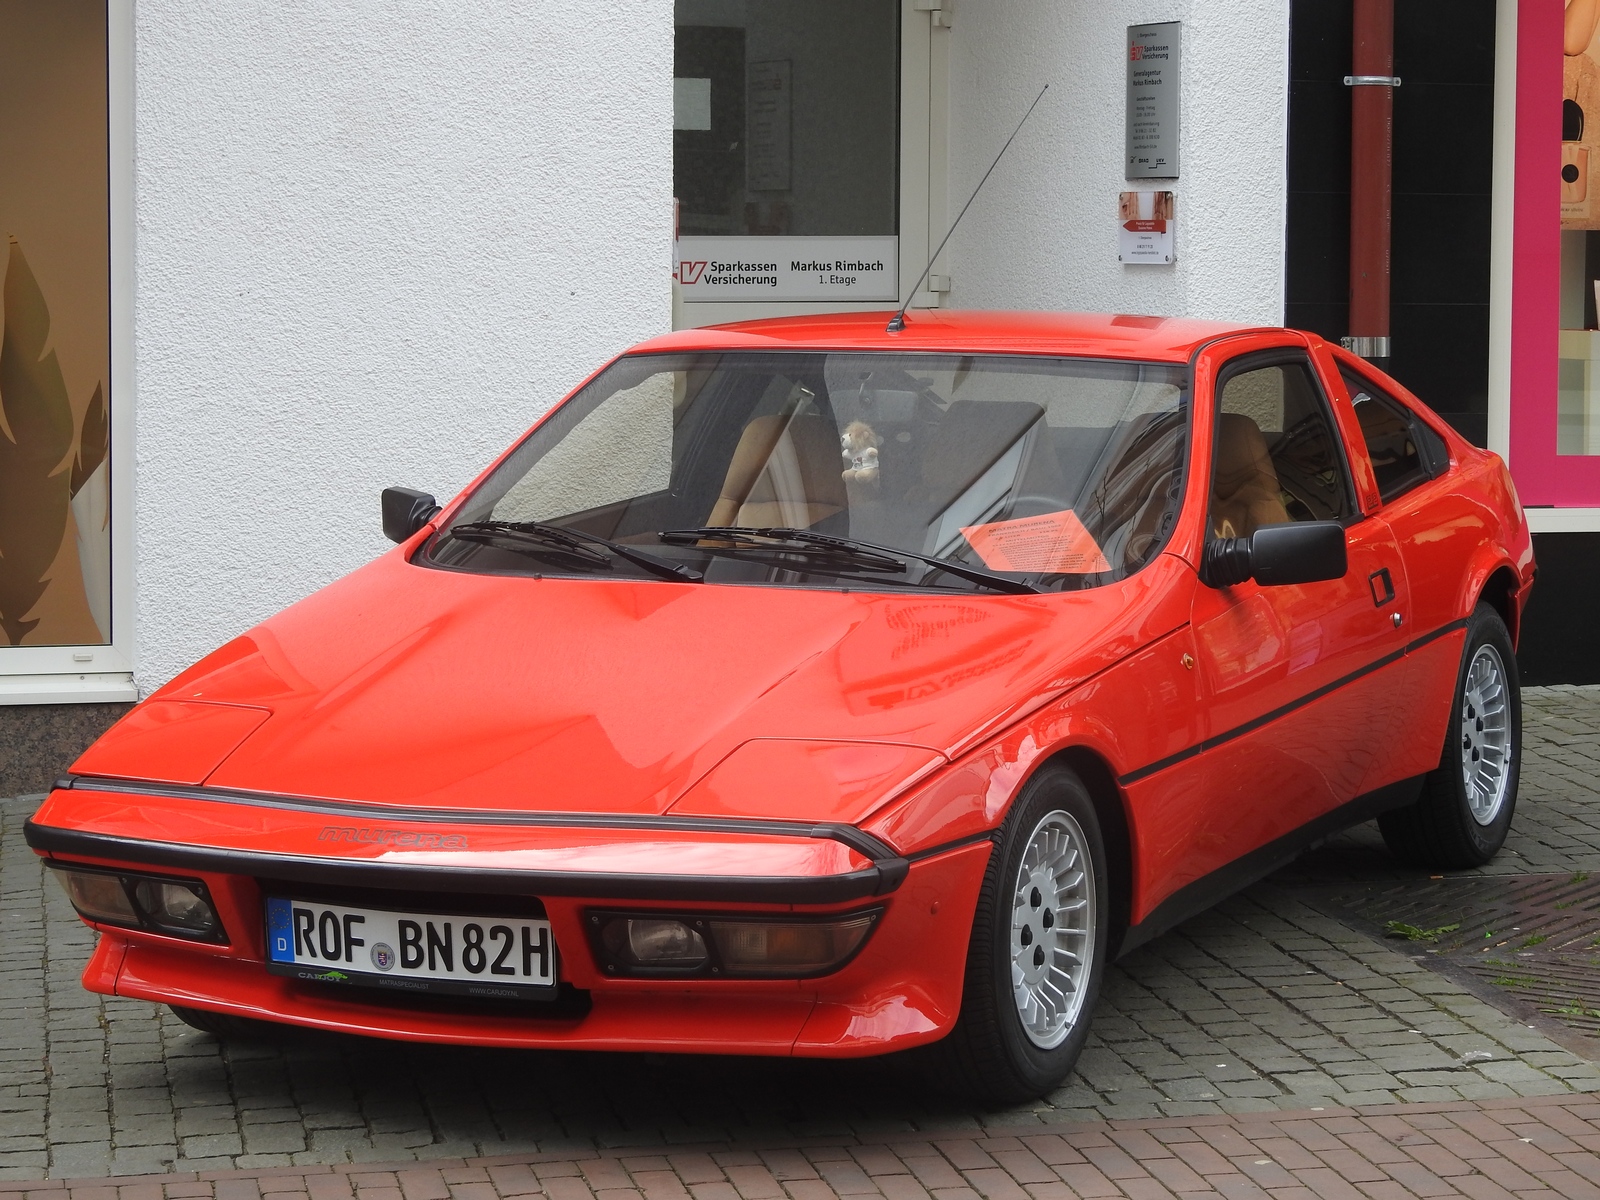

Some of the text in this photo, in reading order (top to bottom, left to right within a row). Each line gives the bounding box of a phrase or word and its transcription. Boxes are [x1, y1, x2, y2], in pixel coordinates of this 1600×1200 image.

[1143, 45, 1169, 53] Sparkassen
[710, 260, 884, 274] Sparkassen Markus Rimbach
[704, 274, 857, 286] Versicherung 1. Etage
[988, 520, 1055, 533] MATRA MURENA
[317, 826, 468, 849] murena
[292, 907, 365, 963] ROF
[276, 936, 287, 951] D
[298, 971, 341, 982] CARJOY
[379, 979, 430, 990] MATRASPECIALIST
